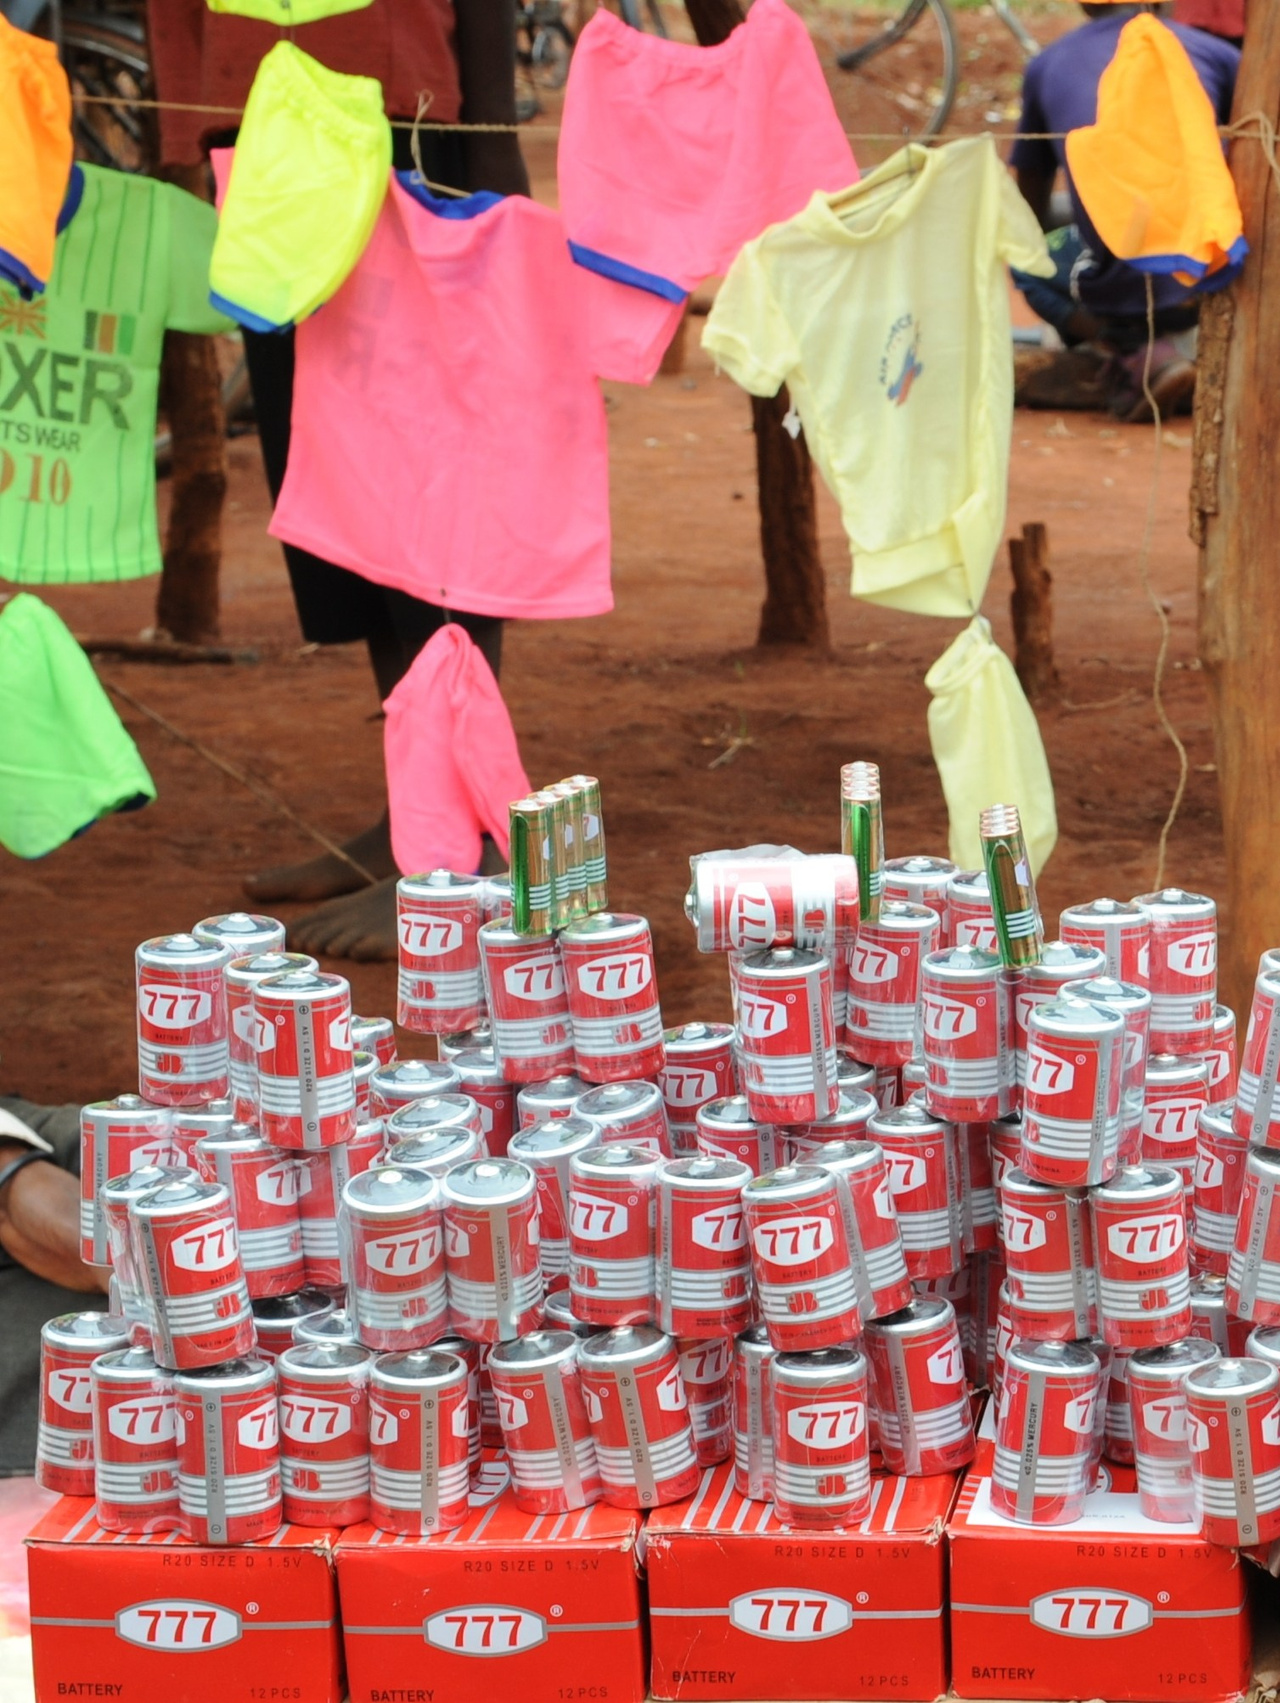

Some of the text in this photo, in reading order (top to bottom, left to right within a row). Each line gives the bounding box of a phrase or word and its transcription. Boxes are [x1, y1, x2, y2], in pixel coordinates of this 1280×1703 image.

[0, 342, 133, 430] XER
[36, 427, 81, 452] WEAR
[401, 919, 452, 947] 777
[737, 894, 766, 948] 777
[514, 958, 566, 993] 77
[587, 957, 645, 992] 777
[144, 989, 200, 1020] 777
[376, 1230, 436, 1268] 777
[761, 1222, 821, 1256] 777
[1119, 1219, 1177, 1254] 777
[282, 1402, 338, 1433] 777
[799, 1407, 858, 1438] 777
[163, 1555, 191, 1566] R20
[201, 1556, 235, 1567] SIZE
[246, 1556, 254, 1567] D
[464, 1561, 491, 1572] R20
[501, 1560, 535, 1572] SIZE
[545, 1560, 553, 1571] D
[775, 1546, 803, 1556] R20
[812, 1547, 846, 1558] SIZE
[856, 1548, 864, 1558] D
[1077, 1546, 1105, 1557] R20
[1114, 1547, 1148, 1558] SIZE
[1158, 1548, 1166, 1558] D
[138, 1610, 216, 1642] 777
[752, 1599, 827, 1632] 777
[1052, 1598, 1129, 1630] 777
[445, 1615, 522, 1647] 777
[58, 1683, 123, 1695] BATTERY
[672, 1671, 736, 1683] BATTERY
[972, 1667, 1035, 1680] BATTERY
[370, 1690, 434, 1702] BATTERY
